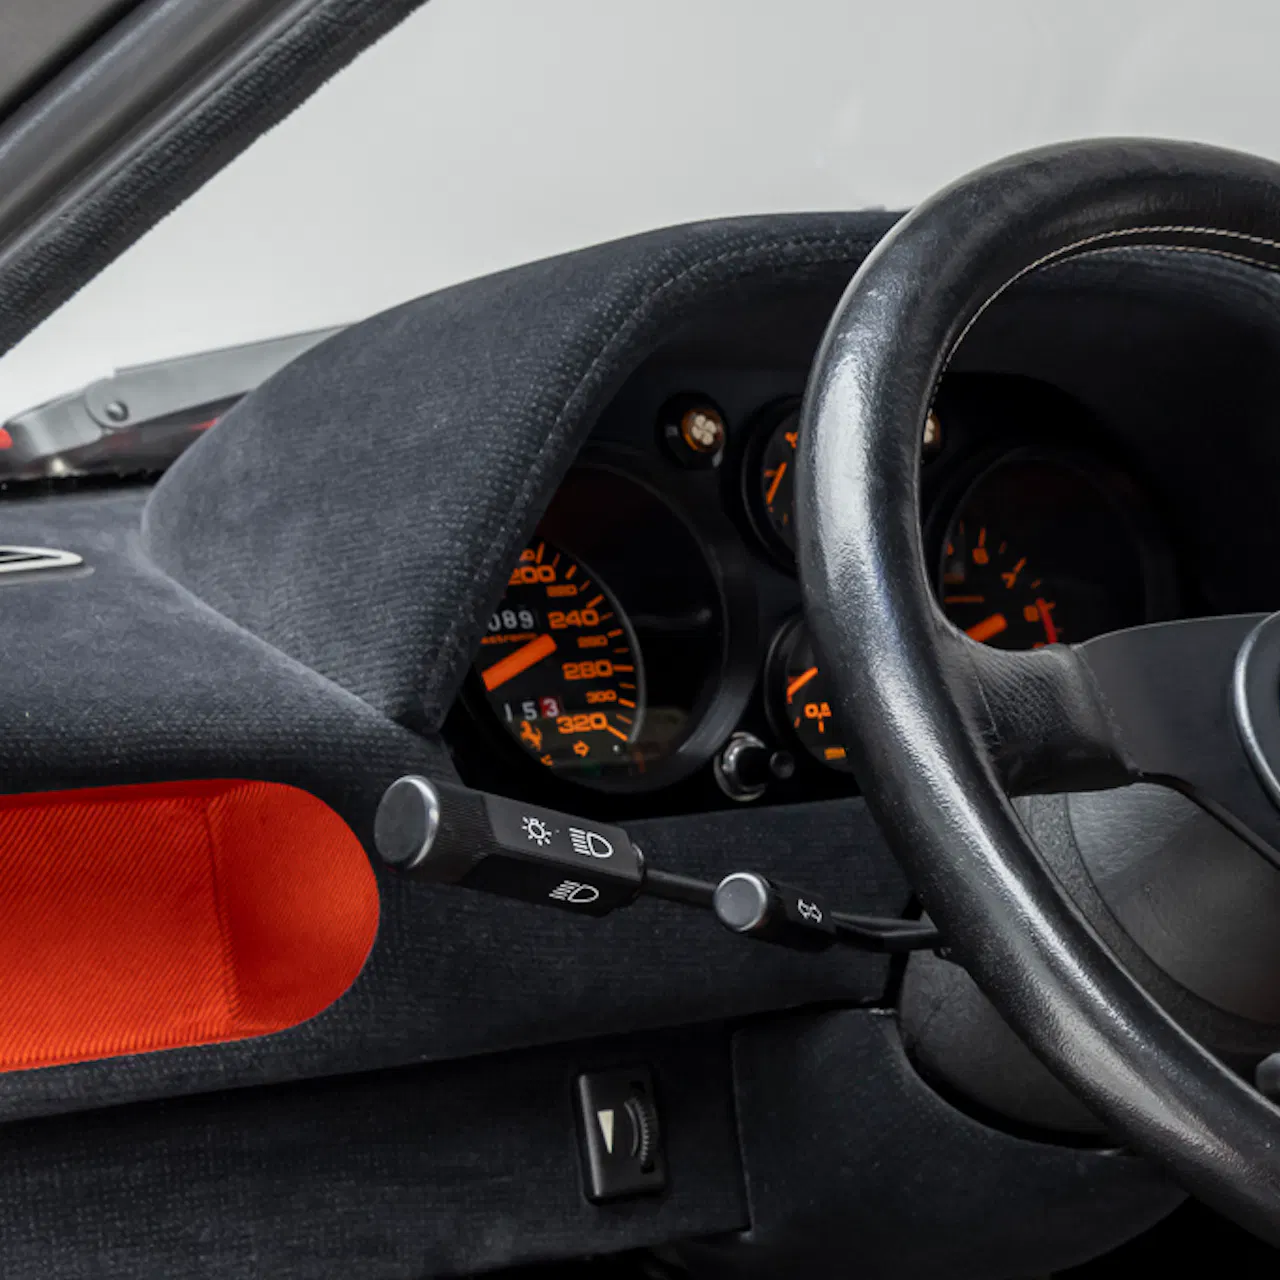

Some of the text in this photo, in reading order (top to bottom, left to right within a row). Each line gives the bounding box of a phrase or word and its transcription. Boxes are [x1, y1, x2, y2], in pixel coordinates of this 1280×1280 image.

[548, 609, 600, 629] 240
[562, 660, 614, 680] 280
[556, 712, 608, 734] 320
